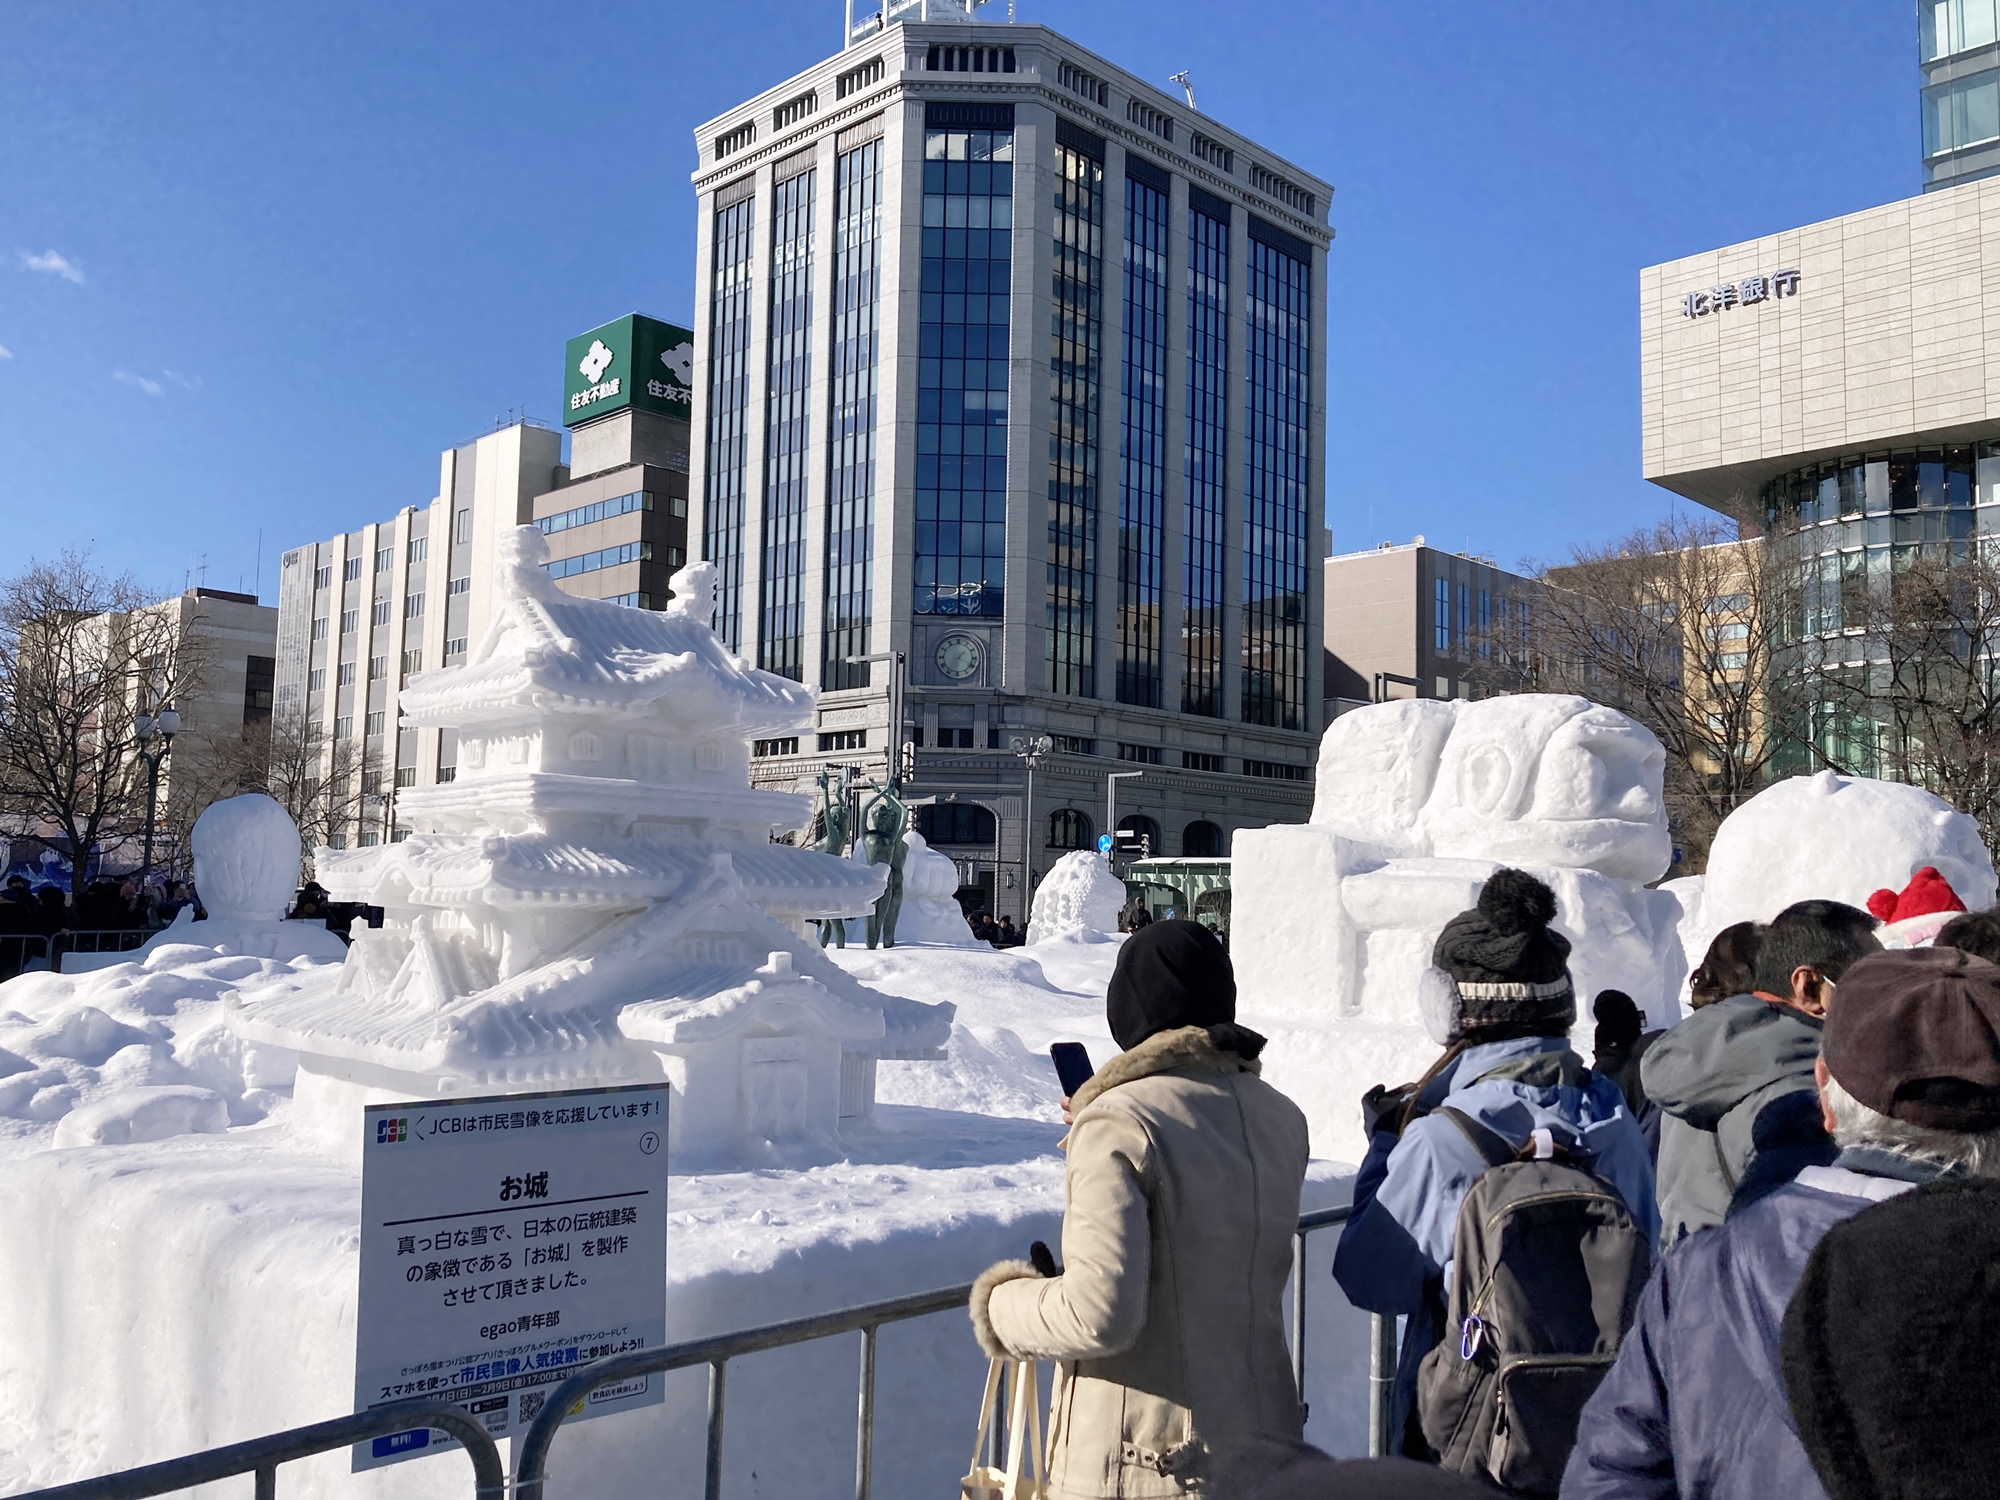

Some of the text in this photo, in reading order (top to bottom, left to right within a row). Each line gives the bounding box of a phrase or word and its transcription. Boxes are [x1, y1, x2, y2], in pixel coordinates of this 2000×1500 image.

[1681, 267, 1799, 317] 北洋銀行
[570, 378, 620, 410] 住友不動産
[429, 1101, 660, 1135] JCBは市民雪像を応援しています!
[499, 1171, 549, 1202] お城
[397, 1207, 637, 1256] 真っ白な雪で、日本の伝統建築
[406, 1235, 629, 1282] の象徴である「お城」を製作
[443, 1271, 588, 1307] させて頂きました。
[480, 1310, 561, 1341] egao青年部
